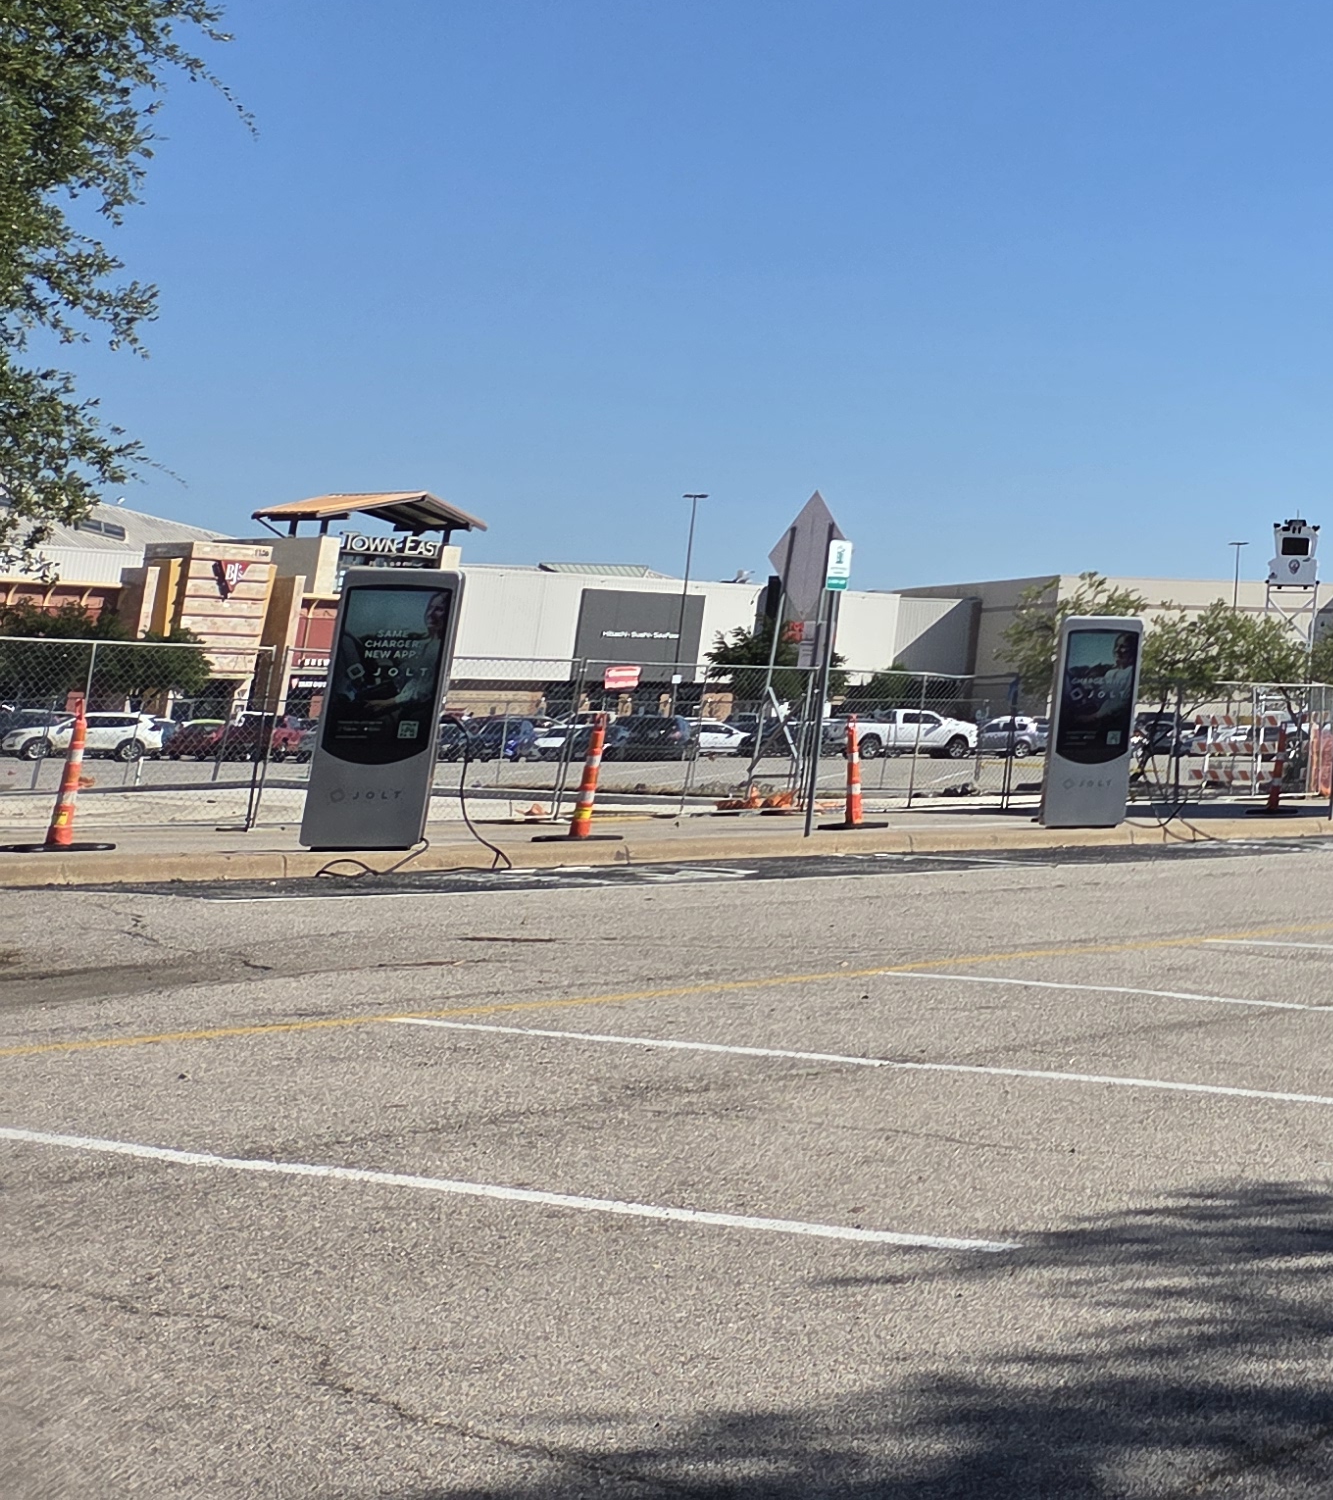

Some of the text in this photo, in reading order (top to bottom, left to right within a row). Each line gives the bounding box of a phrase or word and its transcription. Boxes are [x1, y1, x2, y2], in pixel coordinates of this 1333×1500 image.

[377, 629, 409, 638] SAME
[364, 650, 391, 659] NEW
[372, 667, 429, 677] JOLT
[352, 791, 402, 800] JOLT
